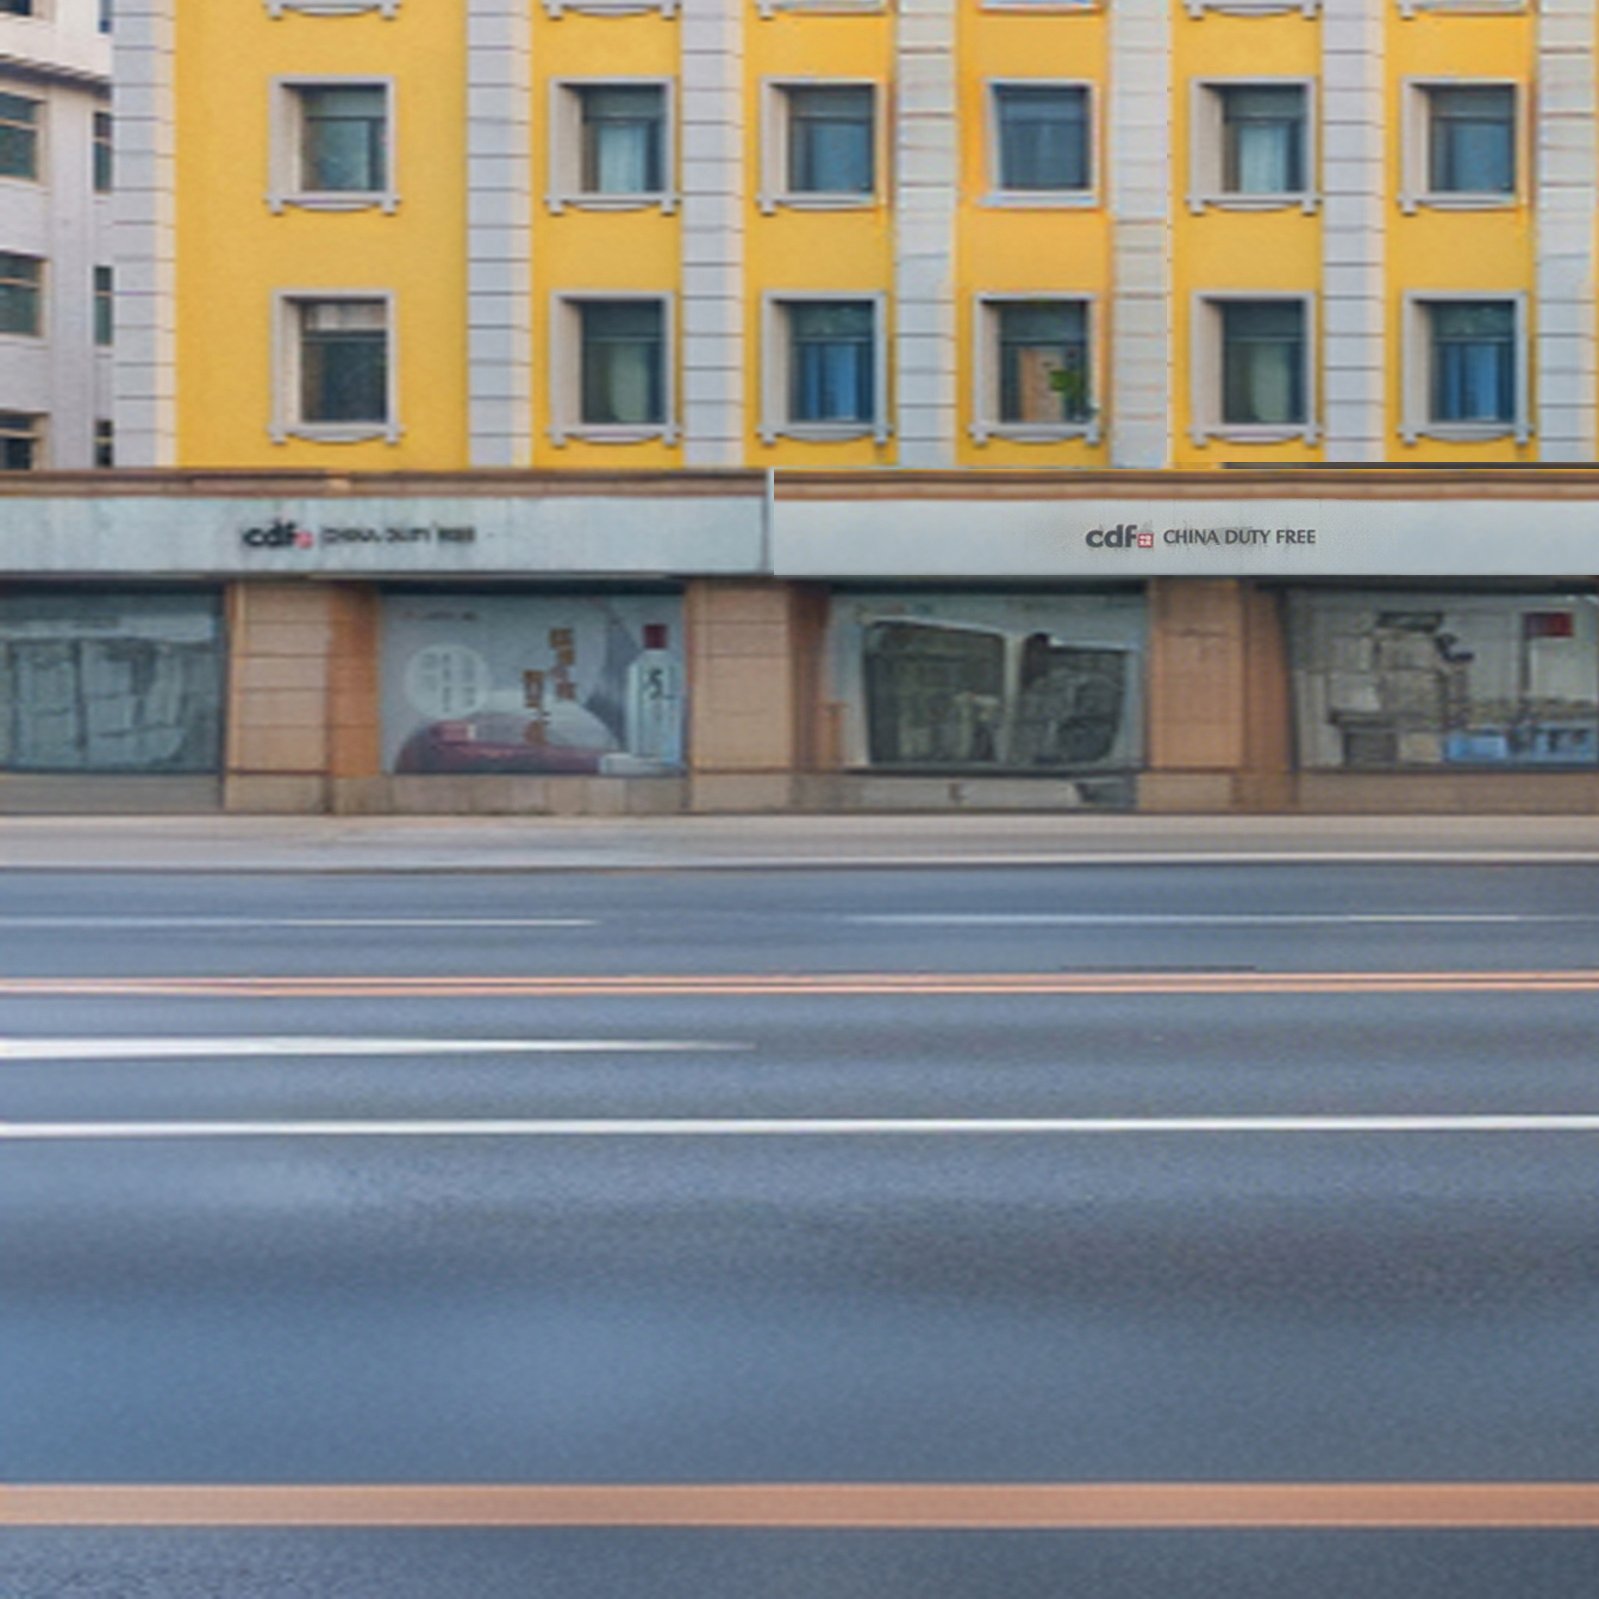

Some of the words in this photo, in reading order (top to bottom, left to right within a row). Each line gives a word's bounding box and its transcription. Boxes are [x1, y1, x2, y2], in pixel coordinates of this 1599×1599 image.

[1085, 524, 1137, 548] cdf
[1163, 529, 1219, 545] CHINA
[1225, 529, 1271, 545] DUTY
[1276, 529, 1316, 545] FREE
